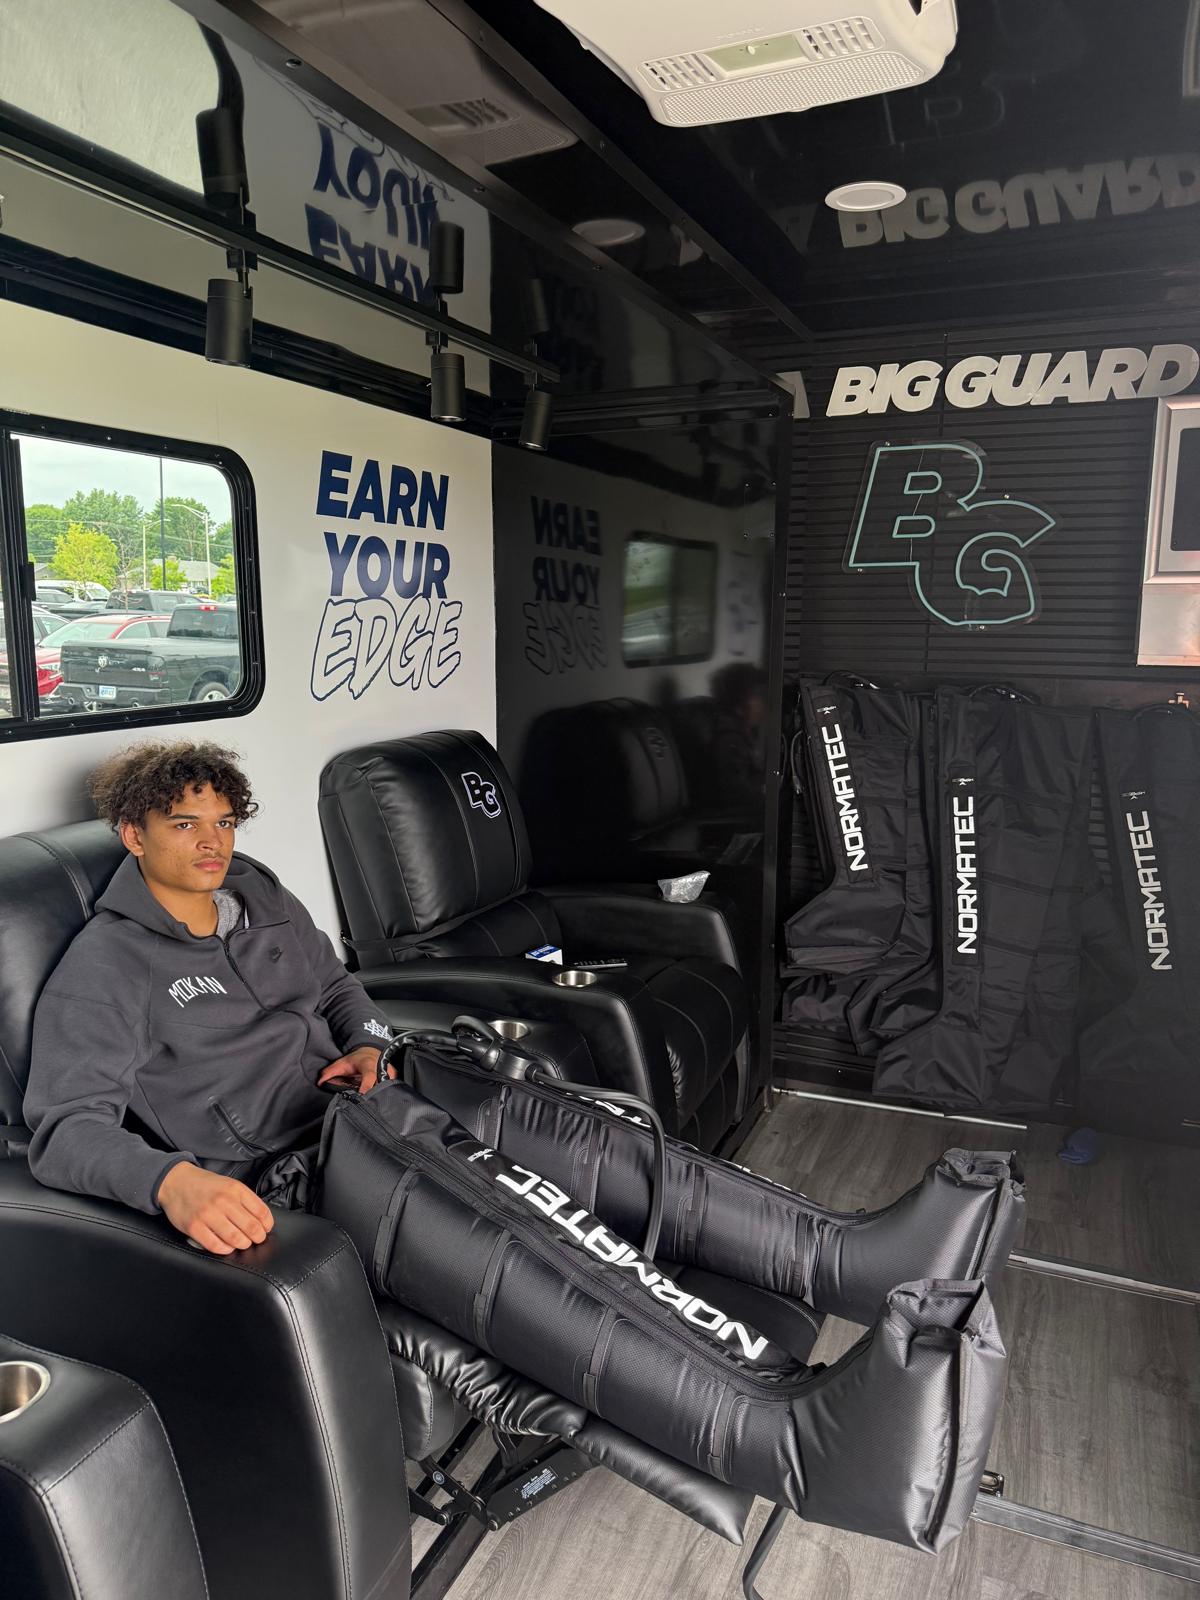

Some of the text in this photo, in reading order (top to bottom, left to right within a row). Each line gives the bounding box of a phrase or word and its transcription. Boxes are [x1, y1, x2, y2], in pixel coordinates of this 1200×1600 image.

[826, 359, 943, 417] BIG
[945, 343, 1200, 409] GUARD
[316, 450, 450, 531] EARN
[849, 443, 1056, 625] BG
[323, 531, 451, 600] YOUR
[311, 594, 463, 702] EDGE
[461, 771, 501, 818] BG
[821, 723, 868, 871] NORMATEC
[953, 796, 977, 954] NORMATEC
[1126, 811, 1173, 971] NORMATEC
[168, 976, 228, 1008] MOKAN
[496, 1164, 769, 1360] NORMATEC
